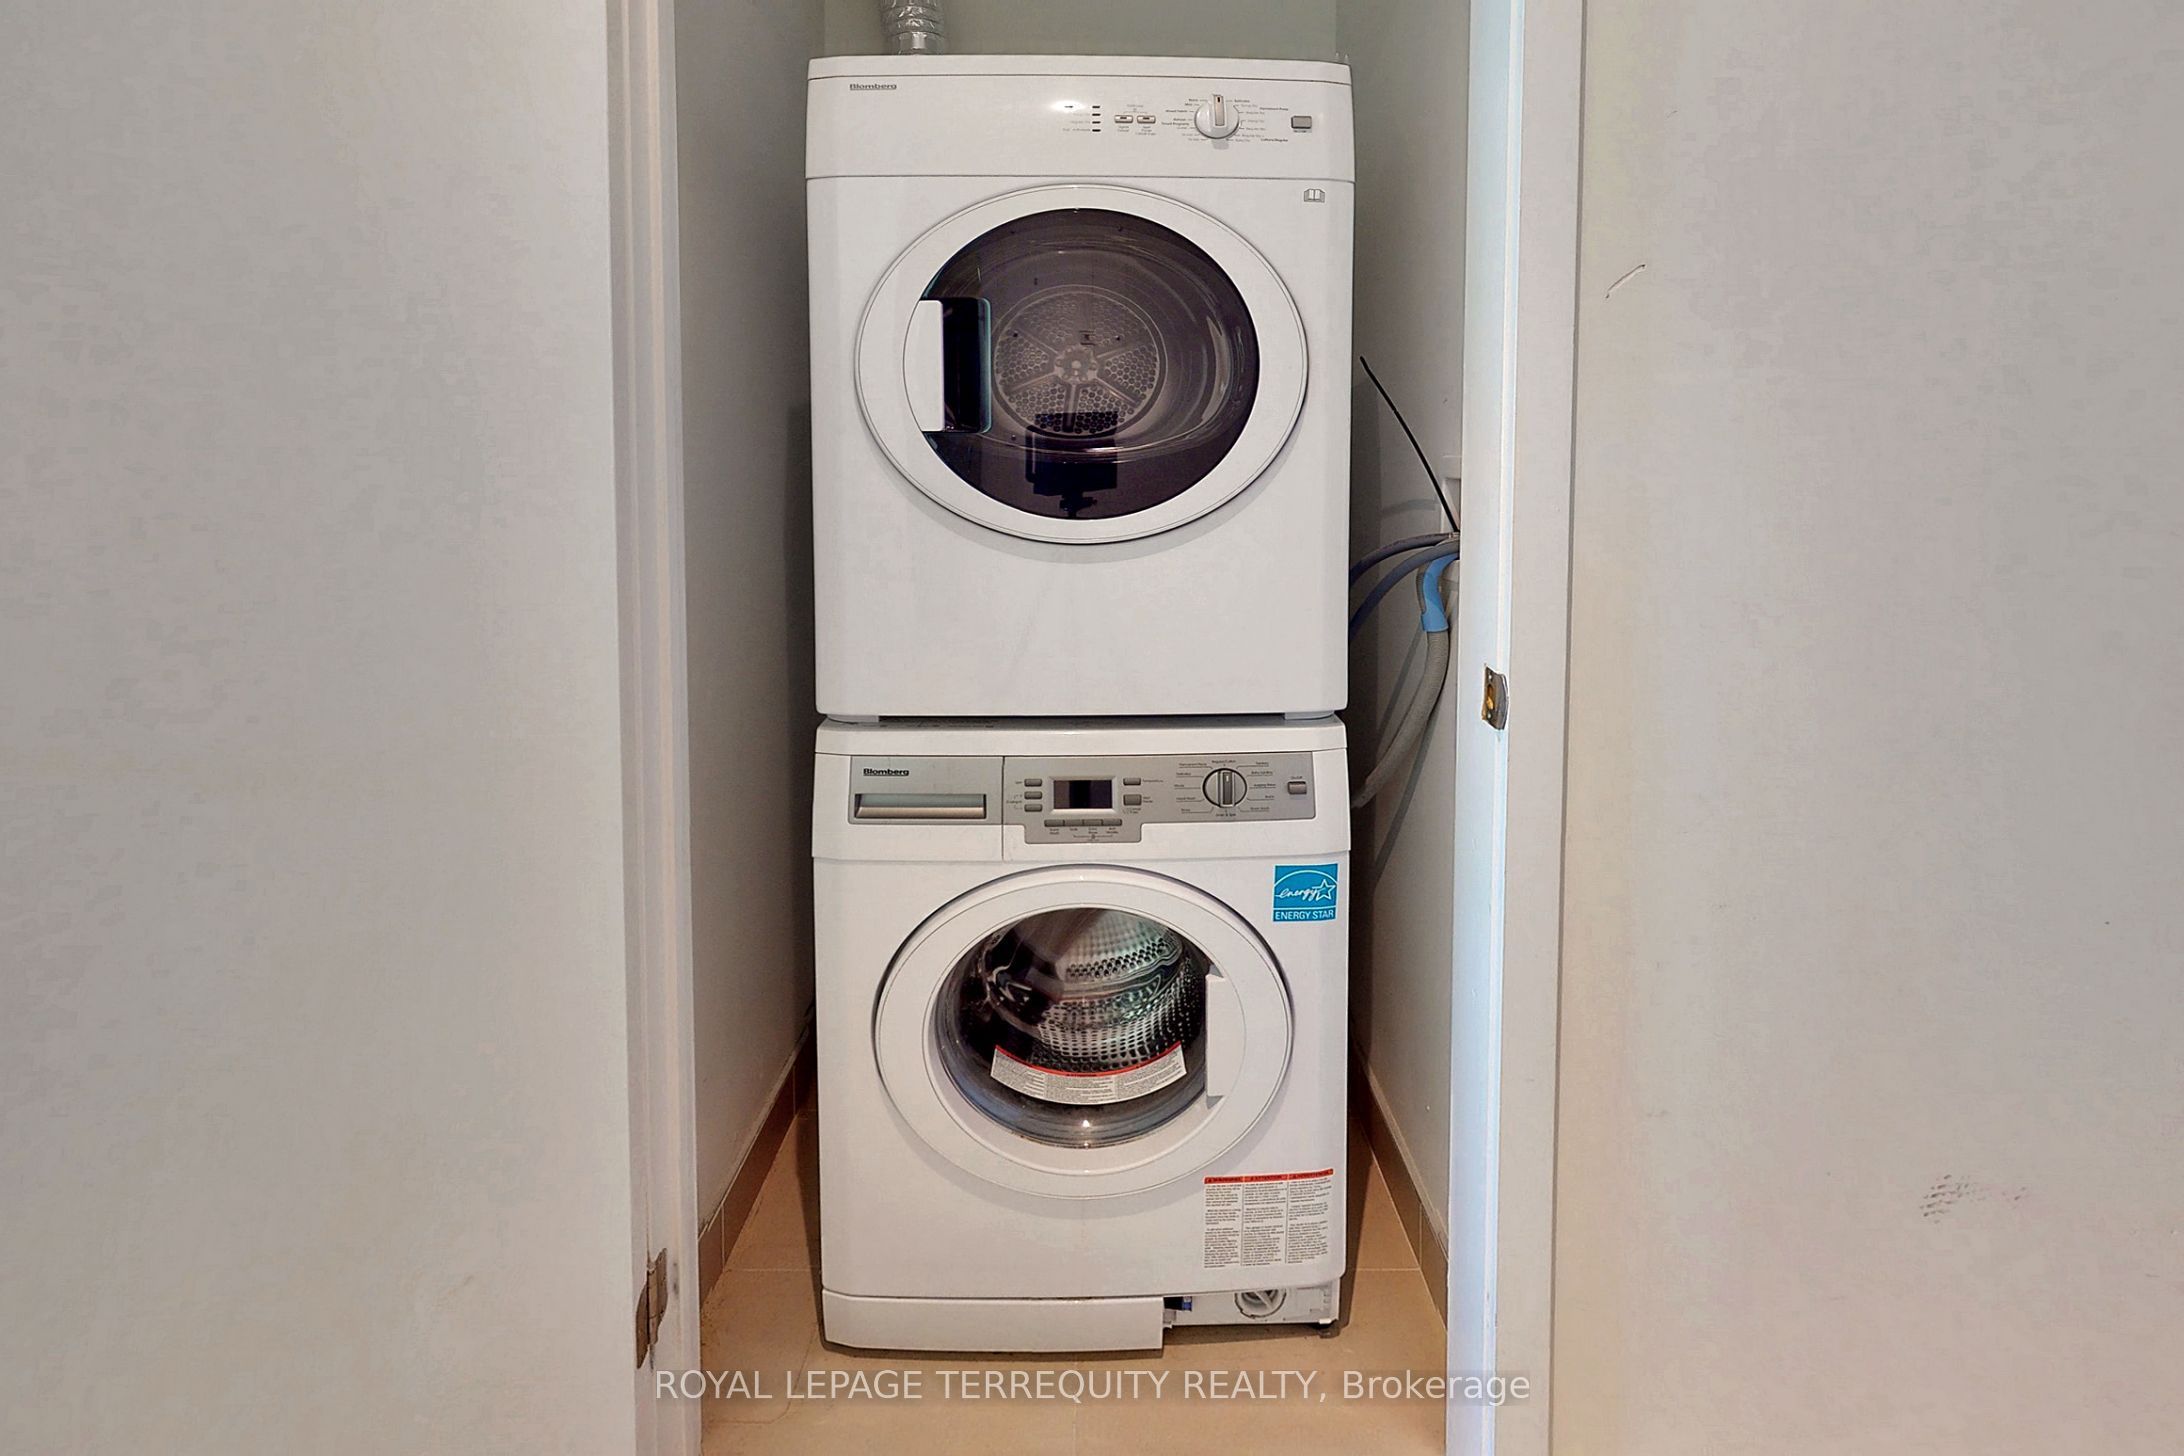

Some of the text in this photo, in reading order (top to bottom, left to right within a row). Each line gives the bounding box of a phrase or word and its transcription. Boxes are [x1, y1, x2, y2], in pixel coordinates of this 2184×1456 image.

[849, 83, 897, 91] Blomberg
[863, 768, 910, 776] Blomberg
[1275, 909, 1334, 921] ENERGY STAR
